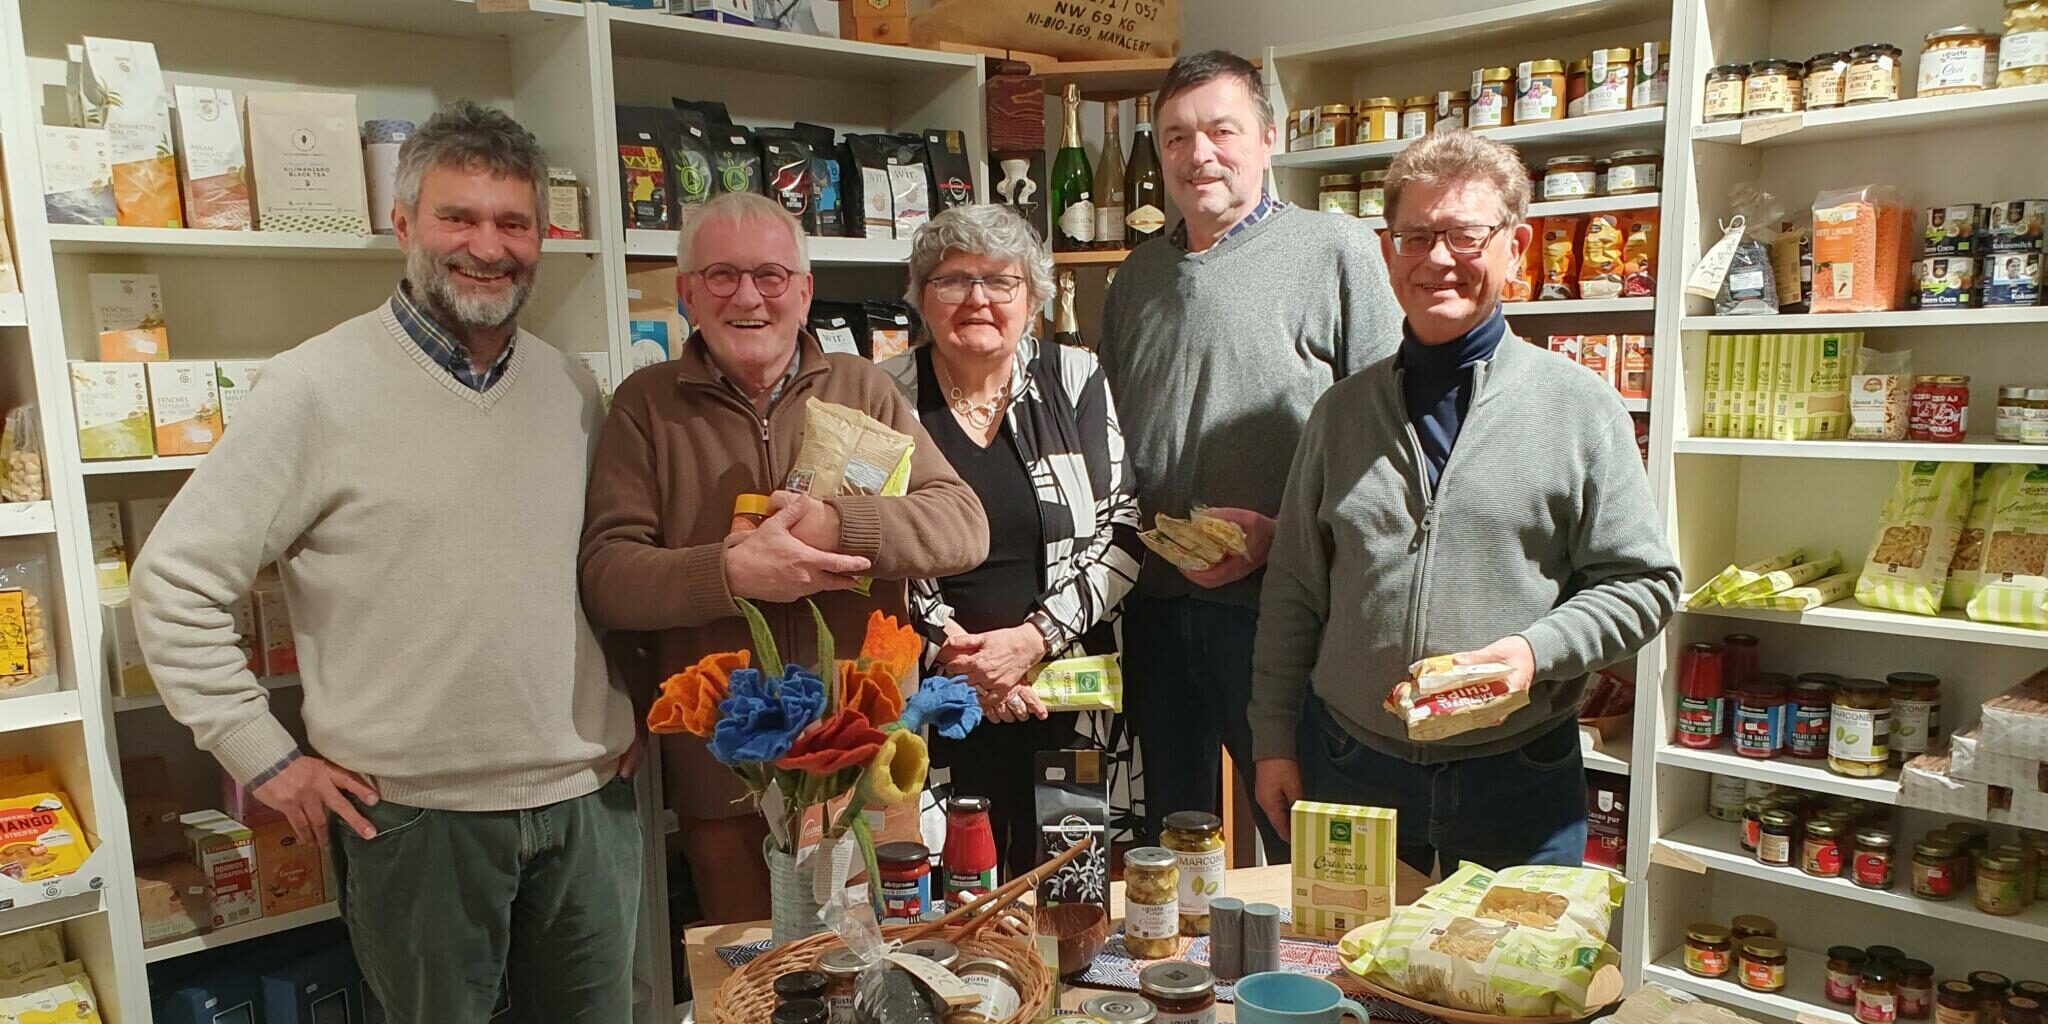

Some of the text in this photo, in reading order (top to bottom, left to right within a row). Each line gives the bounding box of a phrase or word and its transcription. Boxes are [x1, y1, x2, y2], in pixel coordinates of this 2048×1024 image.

[1055, 1, 1087, 19] NW
[1091, 10, 1113, 26] 69
[1118, 17, 1136, 32] KG
[1135, 3, 1158, 21] 051
[1026, 12, 1151, 53] NI-BIO-169, MAYACERT
[1435, 684, 1490, 701] CHIPS
[1314, 856, 1368, 872] Cous cous
